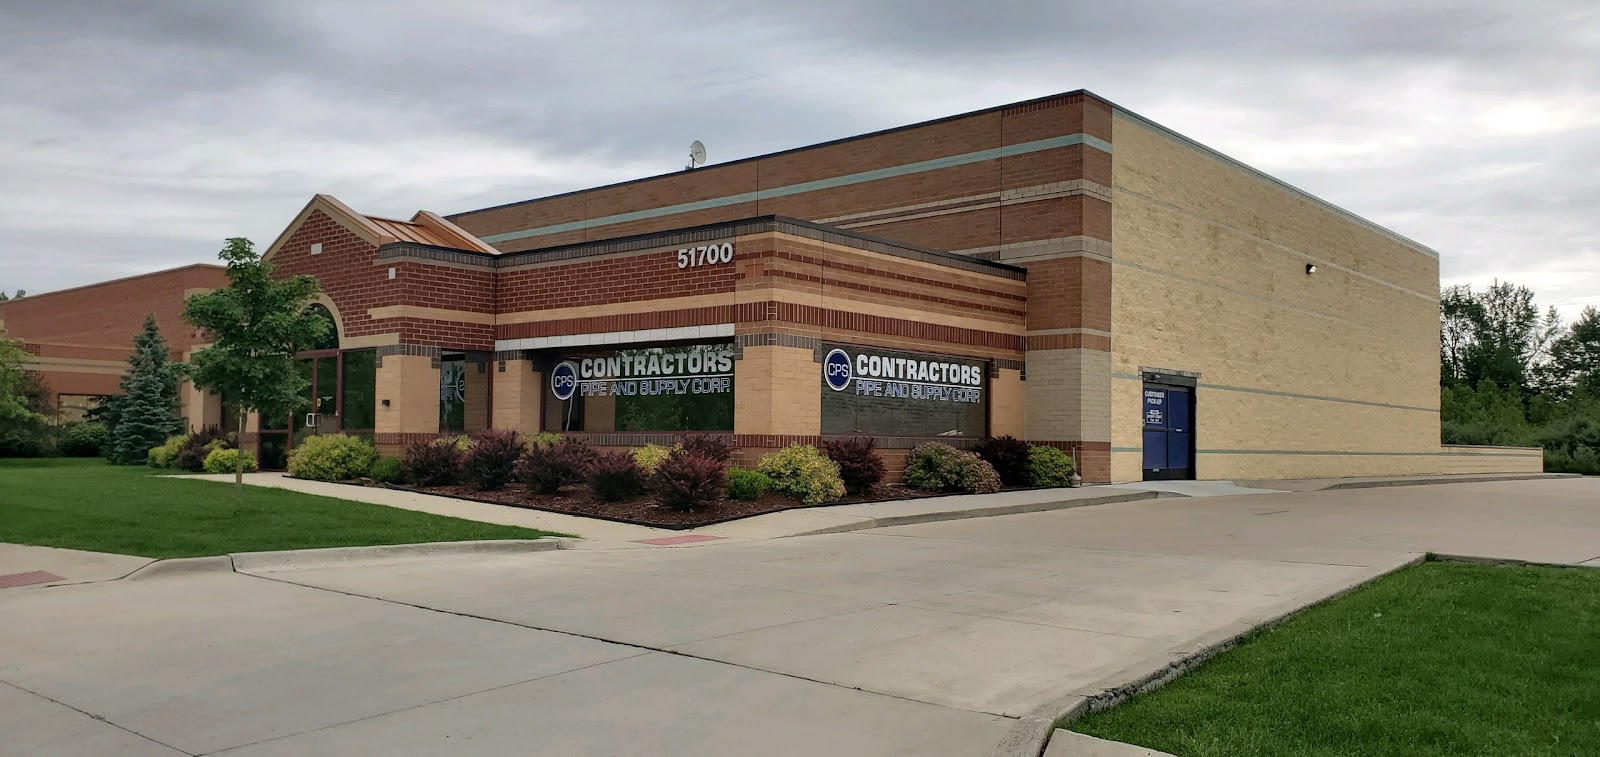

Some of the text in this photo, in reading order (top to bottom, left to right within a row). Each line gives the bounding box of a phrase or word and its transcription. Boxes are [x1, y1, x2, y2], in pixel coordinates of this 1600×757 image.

[677, 242, 733, 269] 51700
[581, 350, 732, 379] CONTRACTORS
[827, 363, 849, 378] CPS
[856, 354, 981, 385] CONTRACTORS
[554, 375, 574, 388] CPS
[580, 378, 731, 397] PIPE AND SUPPLY CORP.
[856, 380, 980, 404] PIPE AND SUPPLY CORP.
[1144, 390, 1165, 398] CUSTOMER
